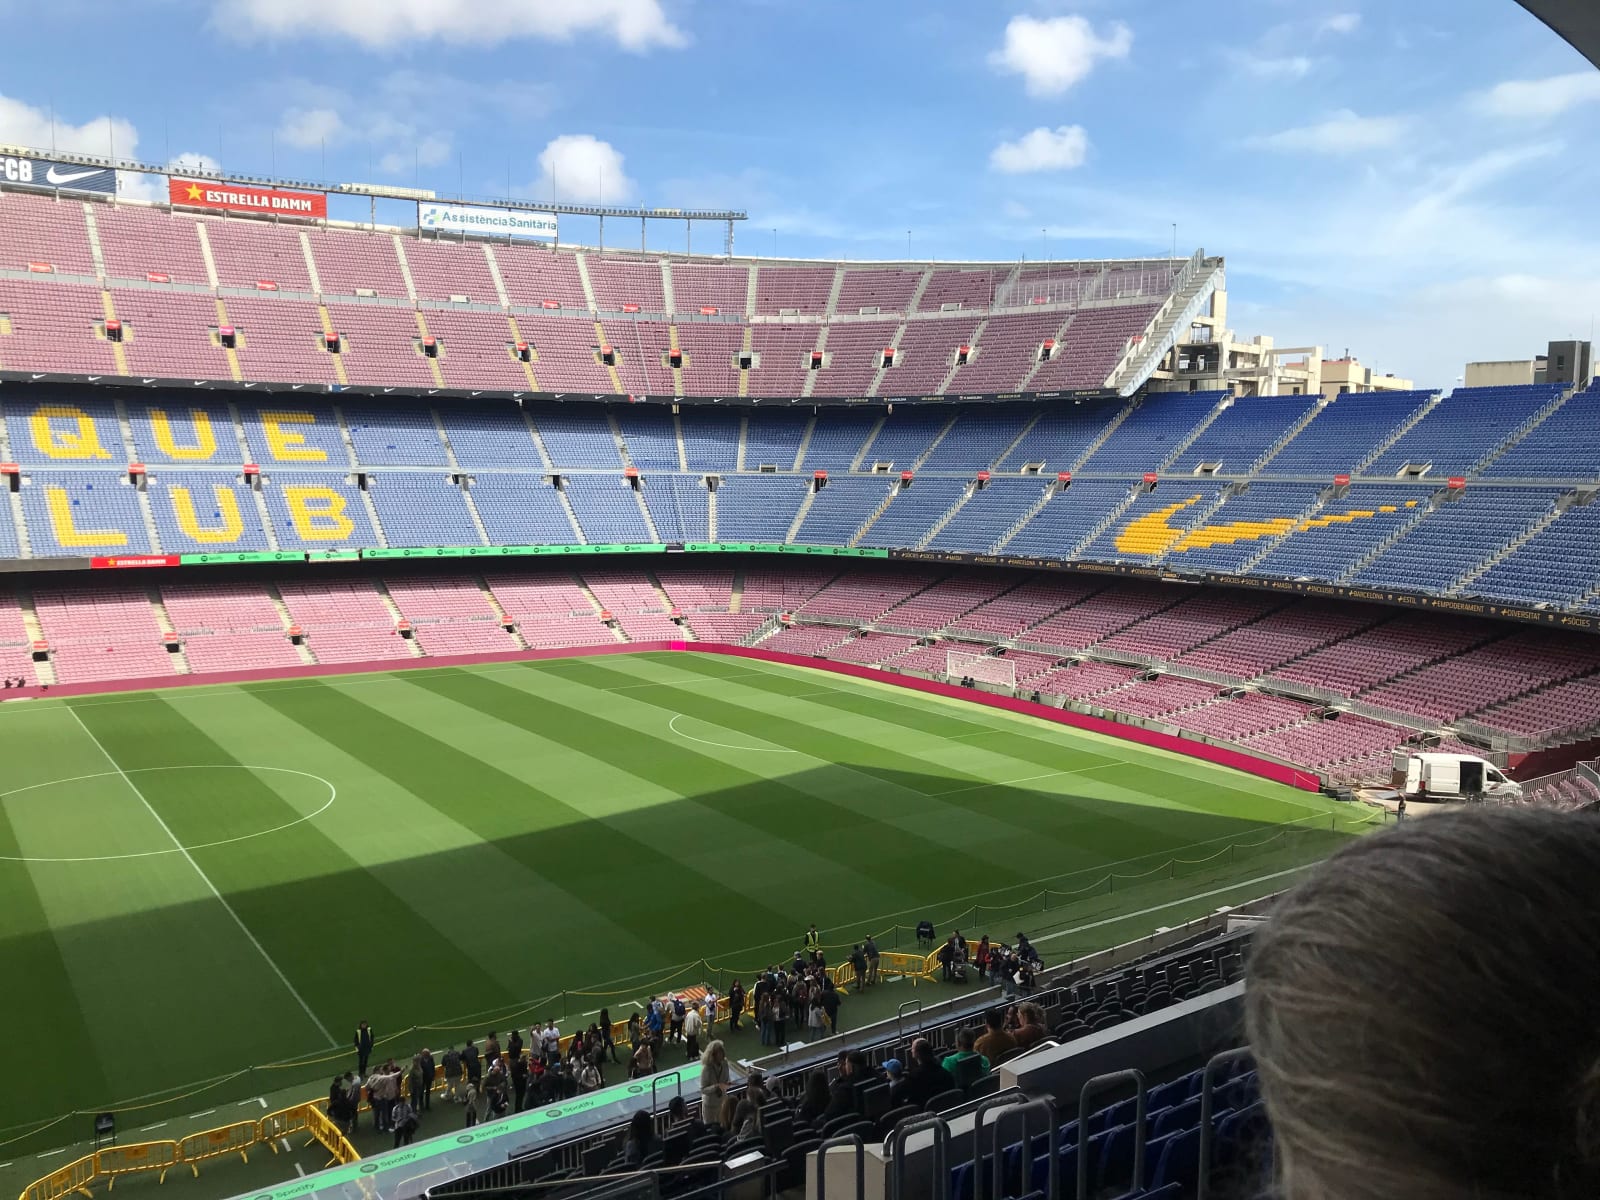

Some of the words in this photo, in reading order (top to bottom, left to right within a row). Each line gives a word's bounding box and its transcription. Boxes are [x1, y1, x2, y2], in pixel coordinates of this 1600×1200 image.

[206, 190, 270, 208] ESTRELLA
[272, 198, 312, 212] DAMM
[442, 211, 508, 226] Assistència
[30, 403, 328, 461] QUE
[379, 1152, 417, 1167] Spotify
[275, 1182, 316, 1198] Spotify
